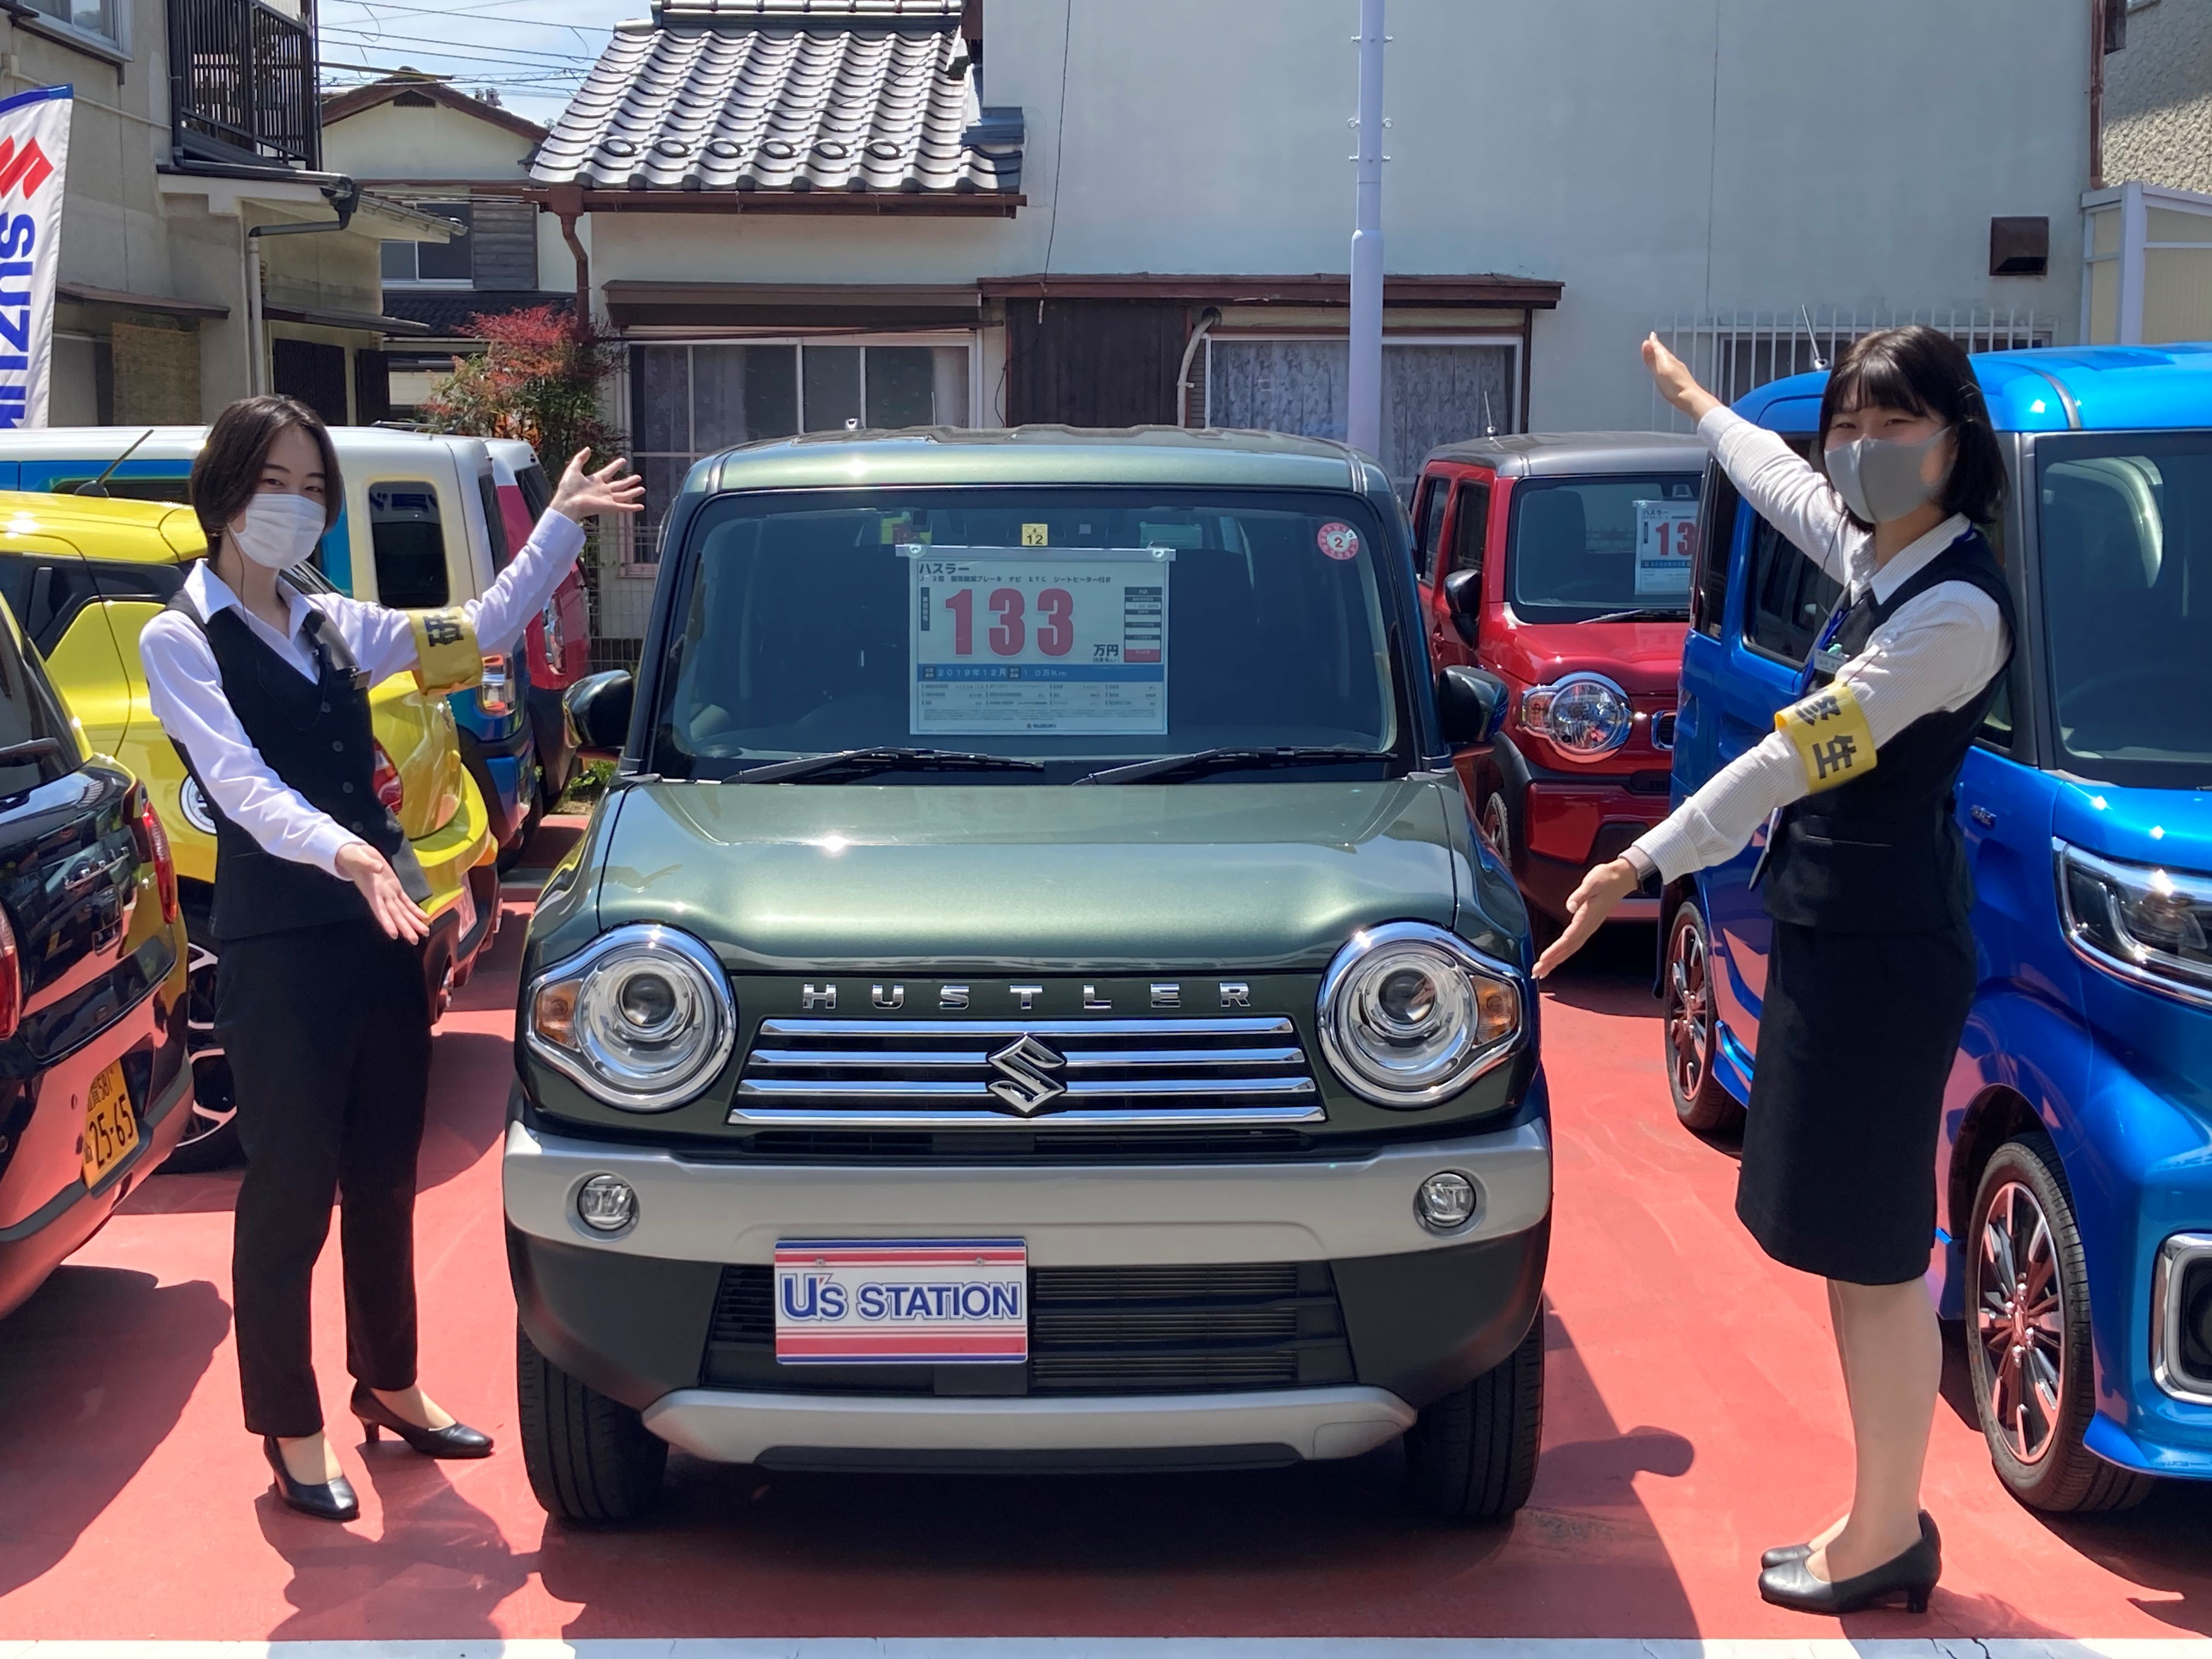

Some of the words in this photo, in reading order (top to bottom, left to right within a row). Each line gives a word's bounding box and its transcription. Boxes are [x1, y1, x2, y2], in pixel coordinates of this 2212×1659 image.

[1026, 534, 1043, 545] 12
[1334, 536, 1344, 548] 2
[919, 563, 970, 574] ハスラー
[945, 588, 1074, 657] 133
[1093, 644, 1119, 657] 万円
[803, 983, 1250, 1010] HUSTLER
[859, 1283, 1021, 1318] STATION
